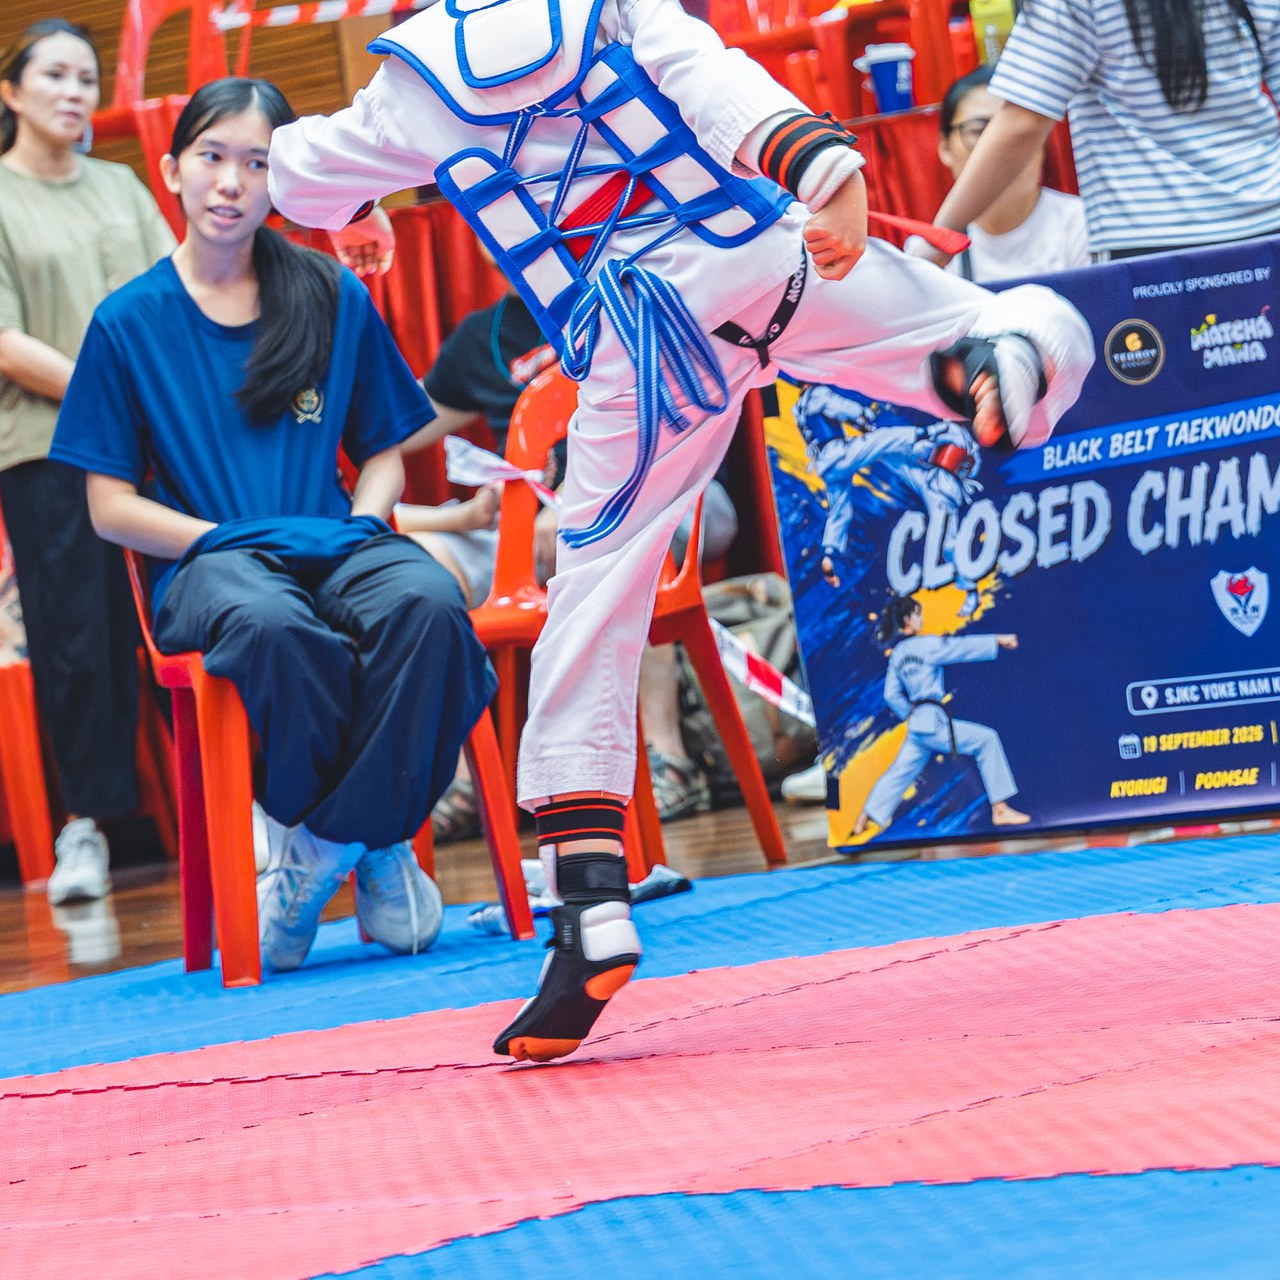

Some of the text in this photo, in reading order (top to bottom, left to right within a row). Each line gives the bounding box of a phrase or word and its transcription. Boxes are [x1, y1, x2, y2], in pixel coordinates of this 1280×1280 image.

[1133, 267, 1271, 300] PROUDLY SPONSORED BY
[1043, 437, 1102, 470] BLACK
[1109, 426, 1157, 459] BELT
[886, 480, 1111, 596] CLOSED
[1165, 684, 1200, 705] SJKC
[1201, 680, 1237, 701] YOKE
[1238, 677, 1270, 697] NAM
[1159, 727, 1230, 752] SEPTEMBER
[1110, 776, 1168, 799] KYORUGI
[1194, 767, 1260, 791] POOMSAE
